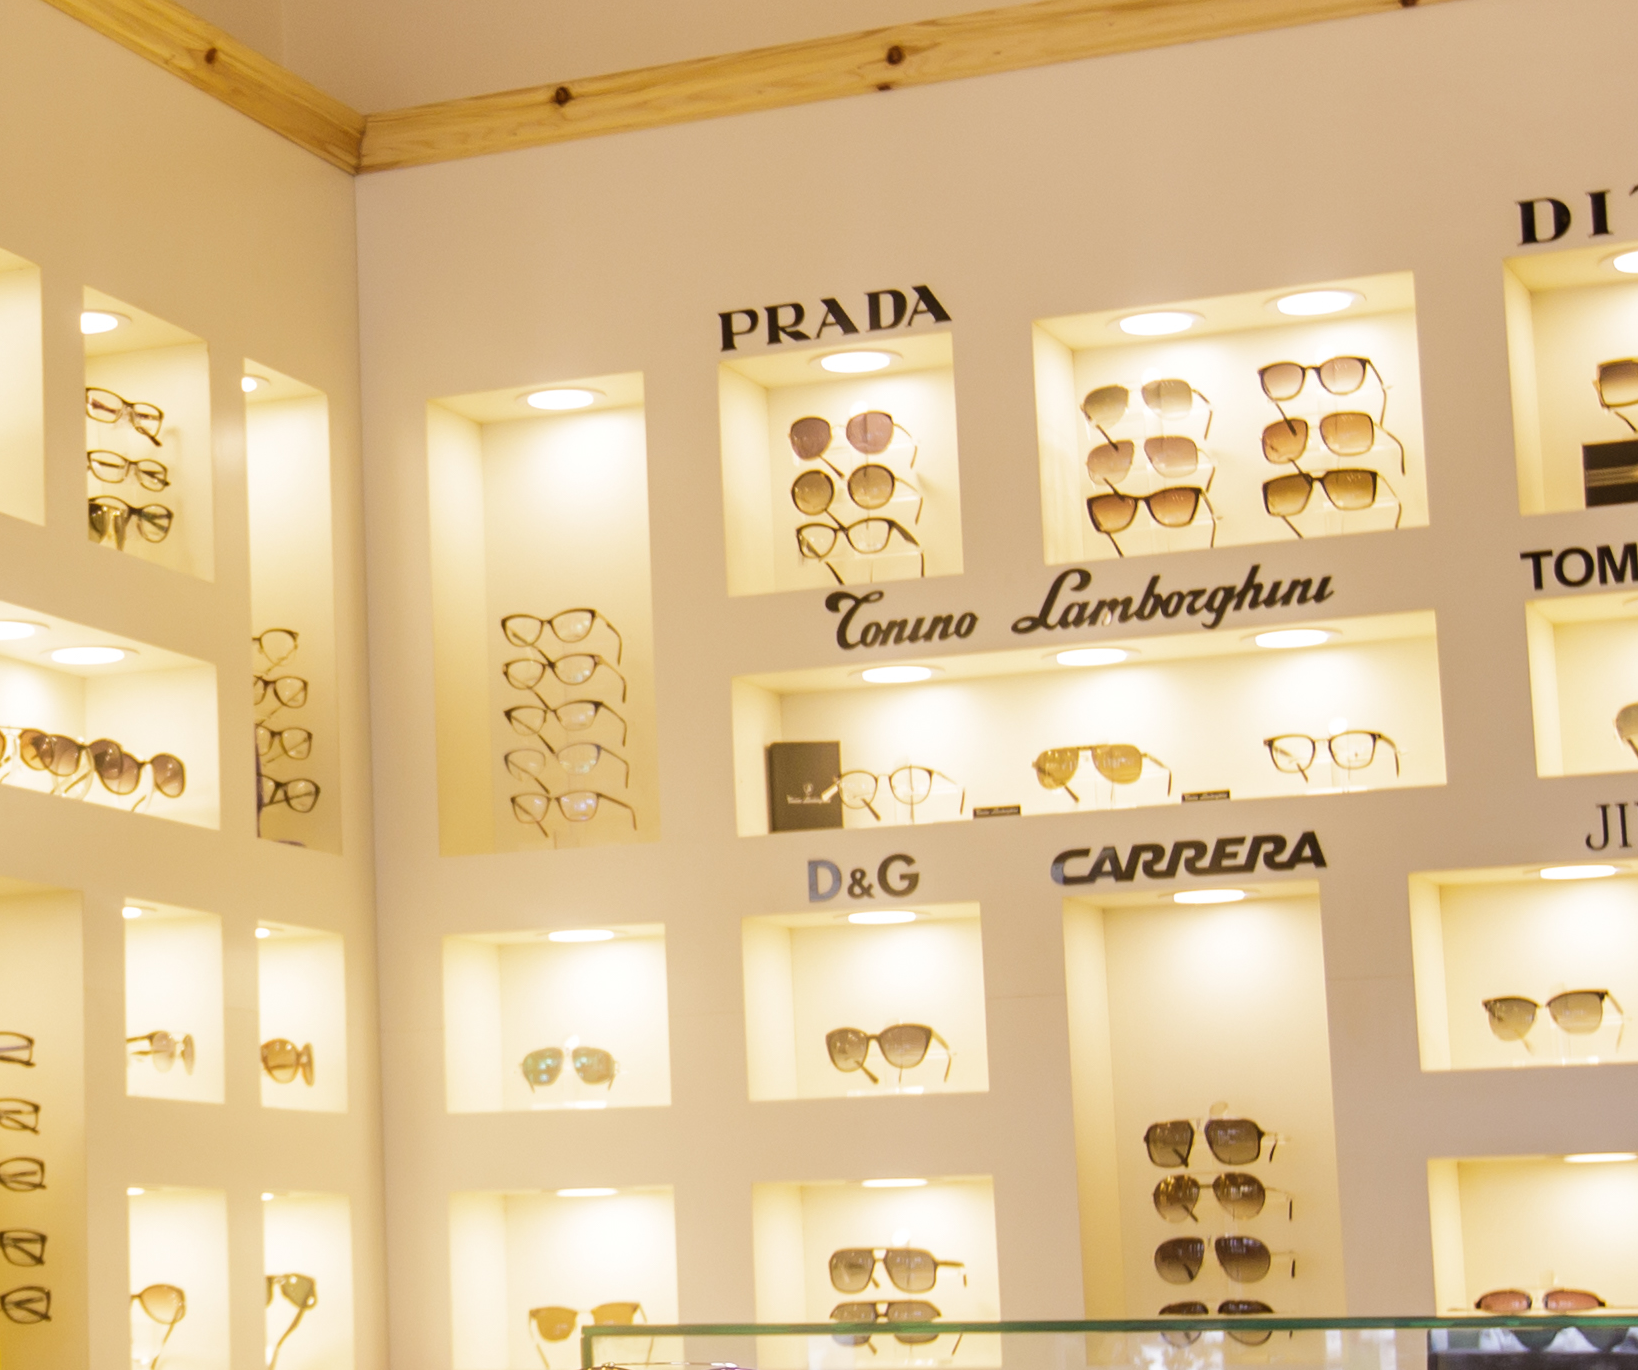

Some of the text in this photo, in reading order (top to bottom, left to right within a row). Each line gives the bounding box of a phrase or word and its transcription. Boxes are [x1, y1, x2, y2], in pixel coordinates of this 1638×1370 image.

[719, 285, 952, 352] PRADA
[824, 564, 1334, 650] Tonino Lamborghini
[807, 854, 920, 902] D&G
[1052, 831, 1327, 886] CARRERA
